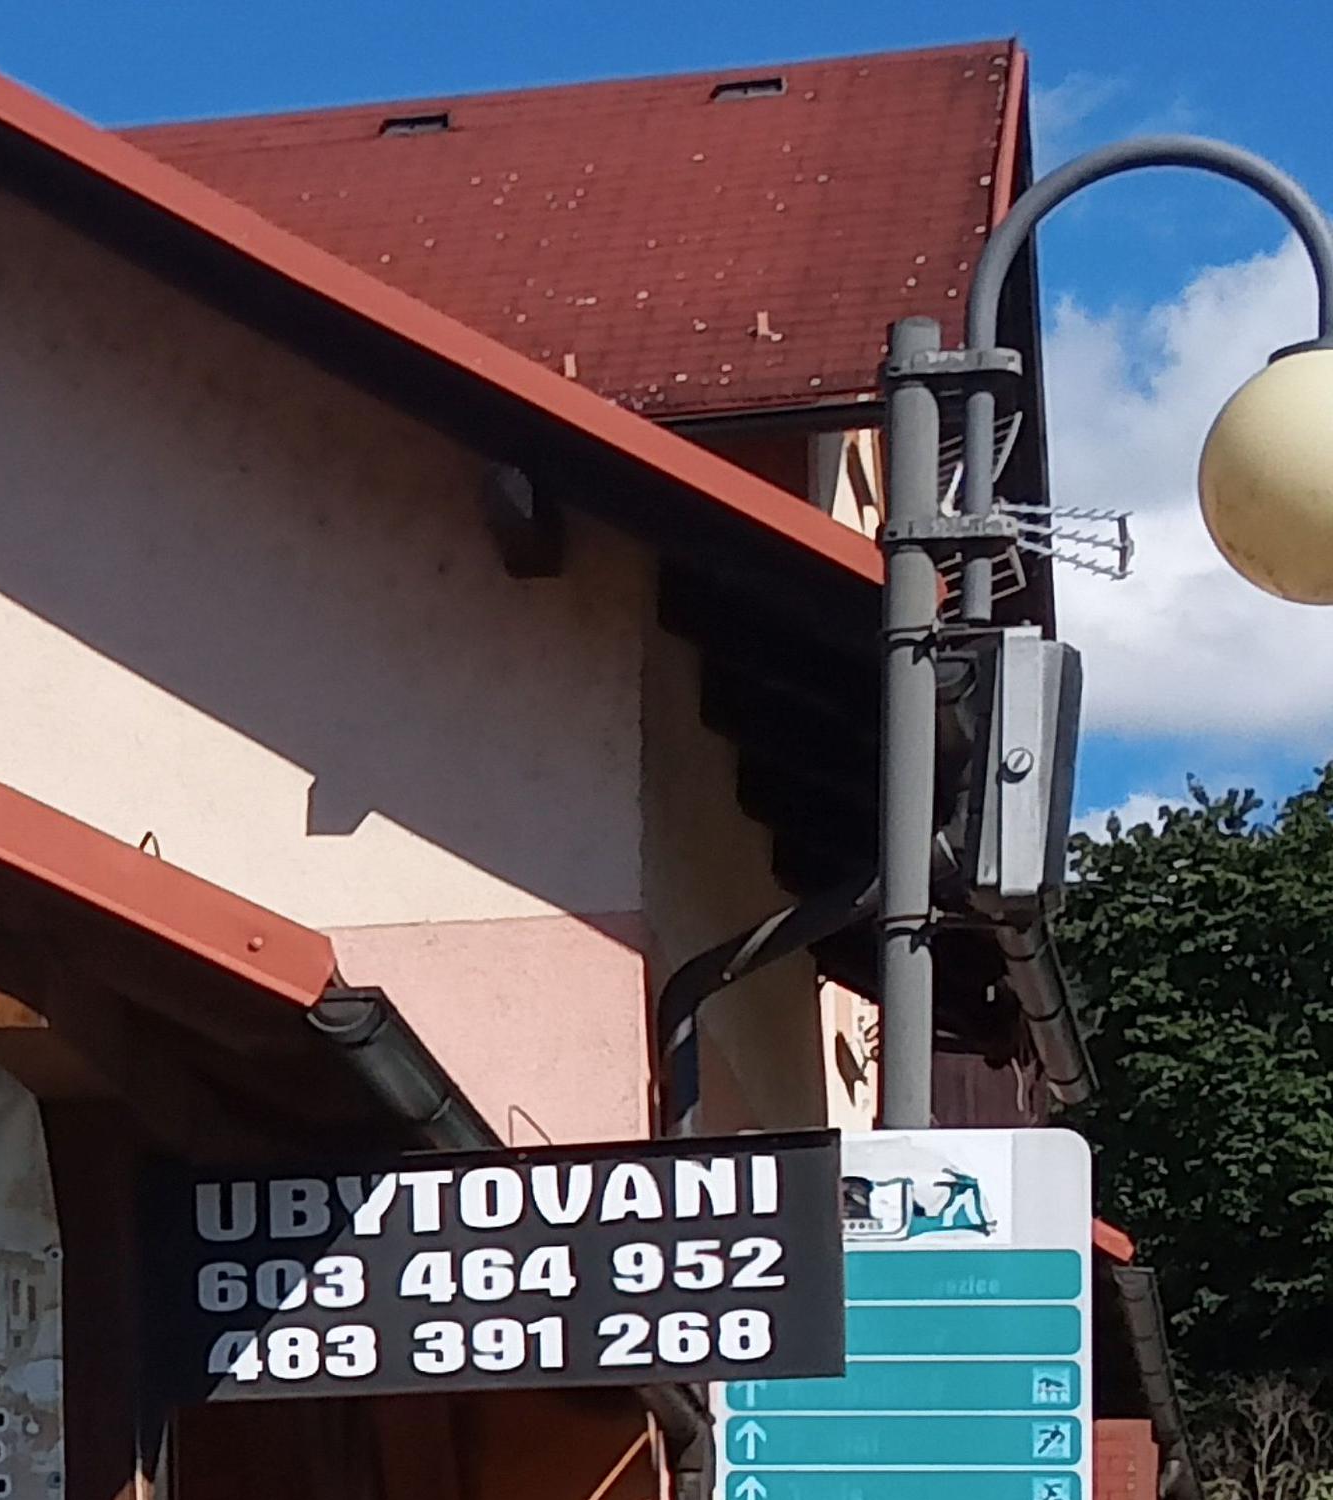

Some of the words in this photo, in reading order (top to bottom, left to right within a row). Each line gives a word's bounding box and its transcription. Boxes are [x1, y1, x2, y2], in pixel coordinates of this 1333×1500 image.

[194, 1154, 779, 1242] UBYTOVANI
[197, 1255, 366, 1313] 603
[398, 1246, 577, 1304] 464
[611, 1237, 786, 1294] 952
[207, 1324, 378, 1382] 483
[411, 1316, 565, 1375] 391
[596, 1309, 773, 1369] 268
